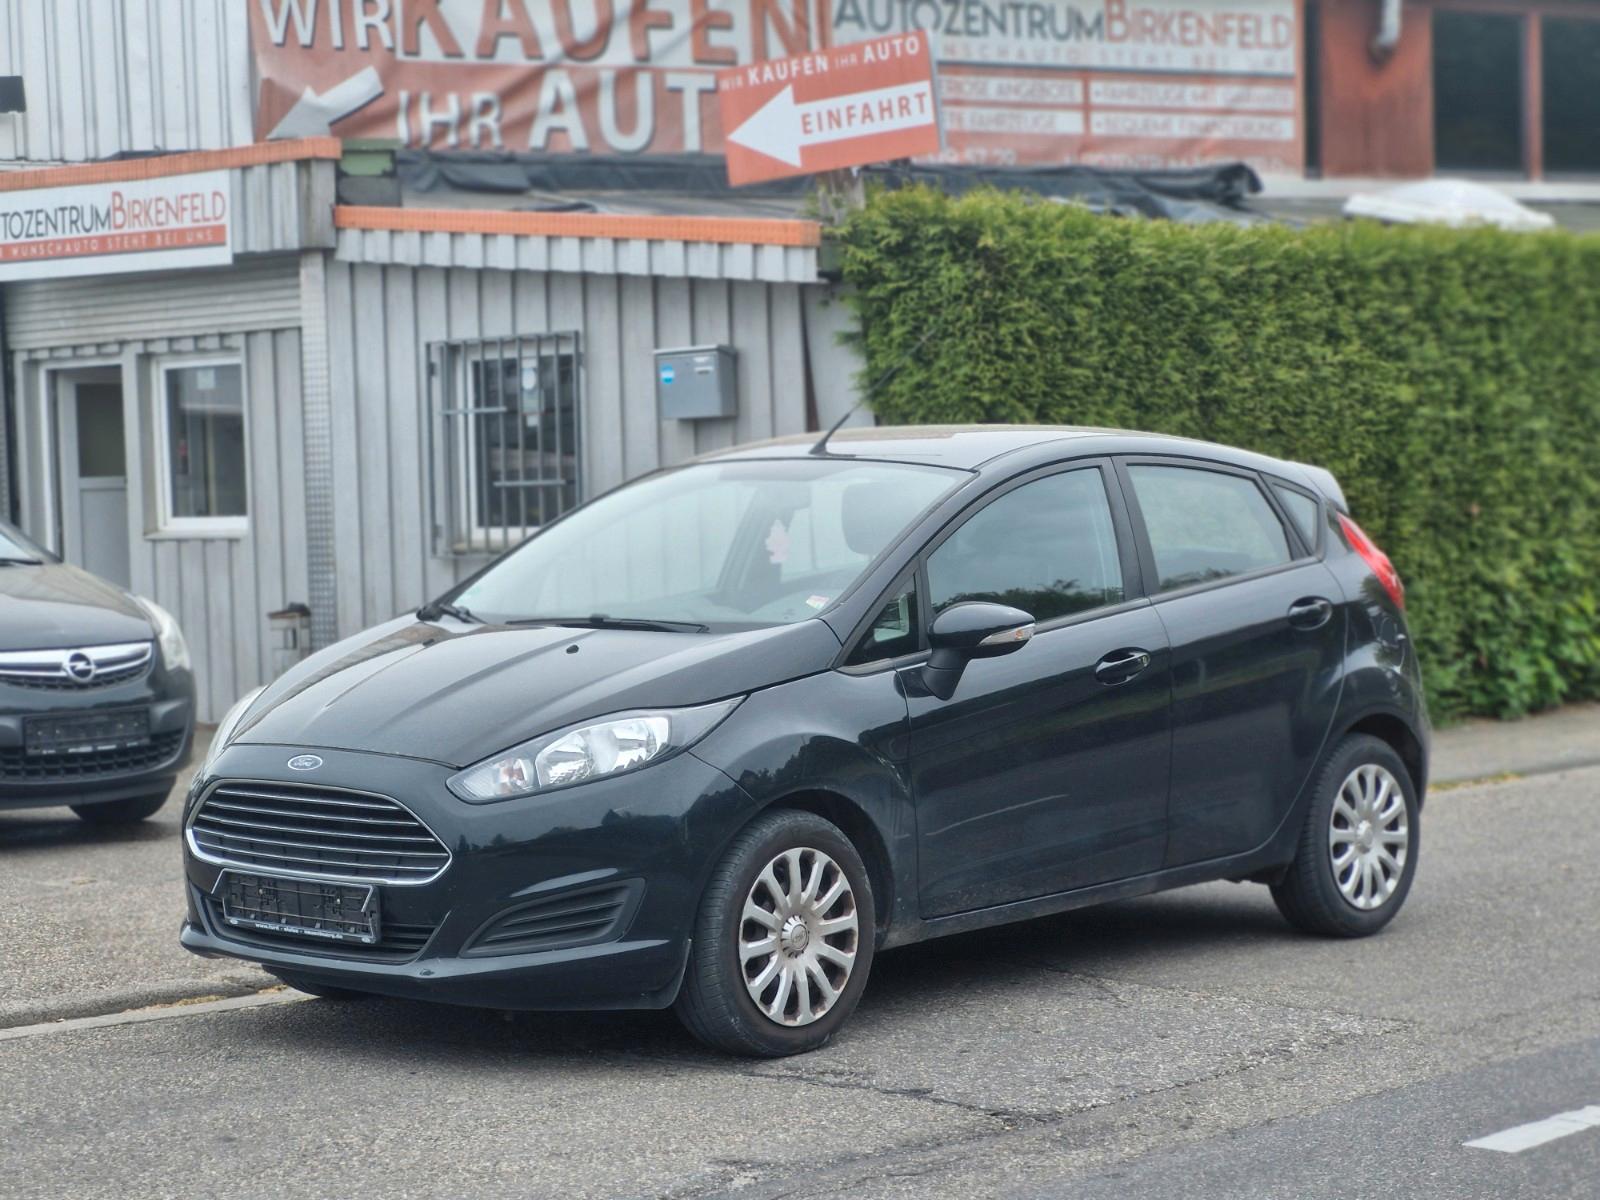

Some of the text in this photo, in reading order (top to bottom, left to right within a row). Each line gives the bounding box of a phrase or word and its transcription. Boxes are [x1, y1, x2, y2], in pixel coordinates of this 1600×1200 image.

[258, 0, 815, 67] WIR KAUFEN
[719, 36, 920, 92] WIR KAUFEN IHR AUTO
[397, 68, 719, 153] IHR AUT
[801, 91, 927, 136] EINFAHRT
[0, 191, 226, 240] TOZENTRUMBIRKENFELD
[12, 239, 99, 257] WUNSCHAUTO
[107, 233, 147, 249] STEHT
[155, 230, 178, 246] BEI
[187, 228, 214, 243] UNS
